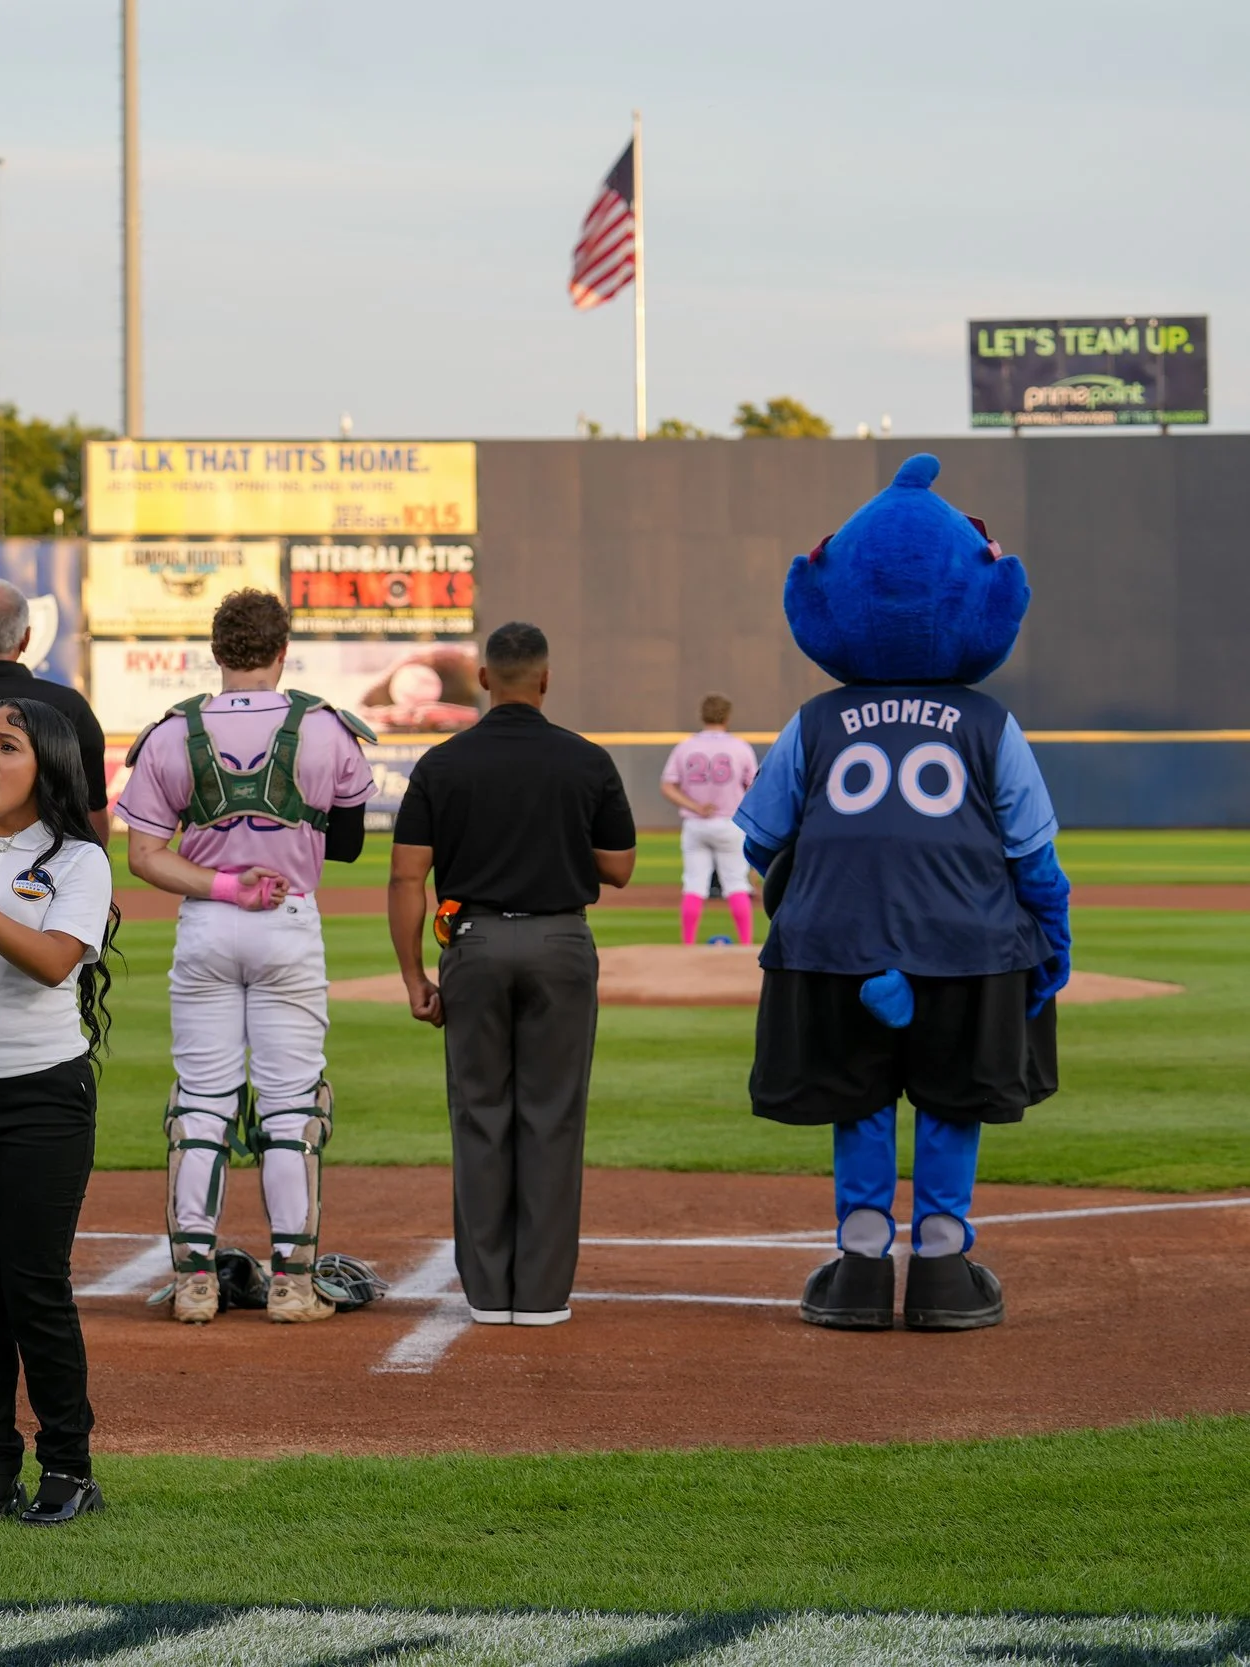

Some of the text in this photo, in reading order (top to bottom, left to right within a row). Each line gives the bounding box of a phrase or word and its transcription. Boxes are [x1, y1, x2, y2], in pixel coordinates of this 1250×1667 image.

[978, 325, 1194, 357] LET'S TEAM UP.
[1024, 382, 1145, 410] primepoint
[107, 448, 431, 473] TALK THAT HITS HOME.
[290, 545, 474, 572] INTERGALACTIC
[291, 572, 474, 608] FIREWORKS
[840, 699, 961, 735] BOOMER
[826, 741, 968, 818] 00
